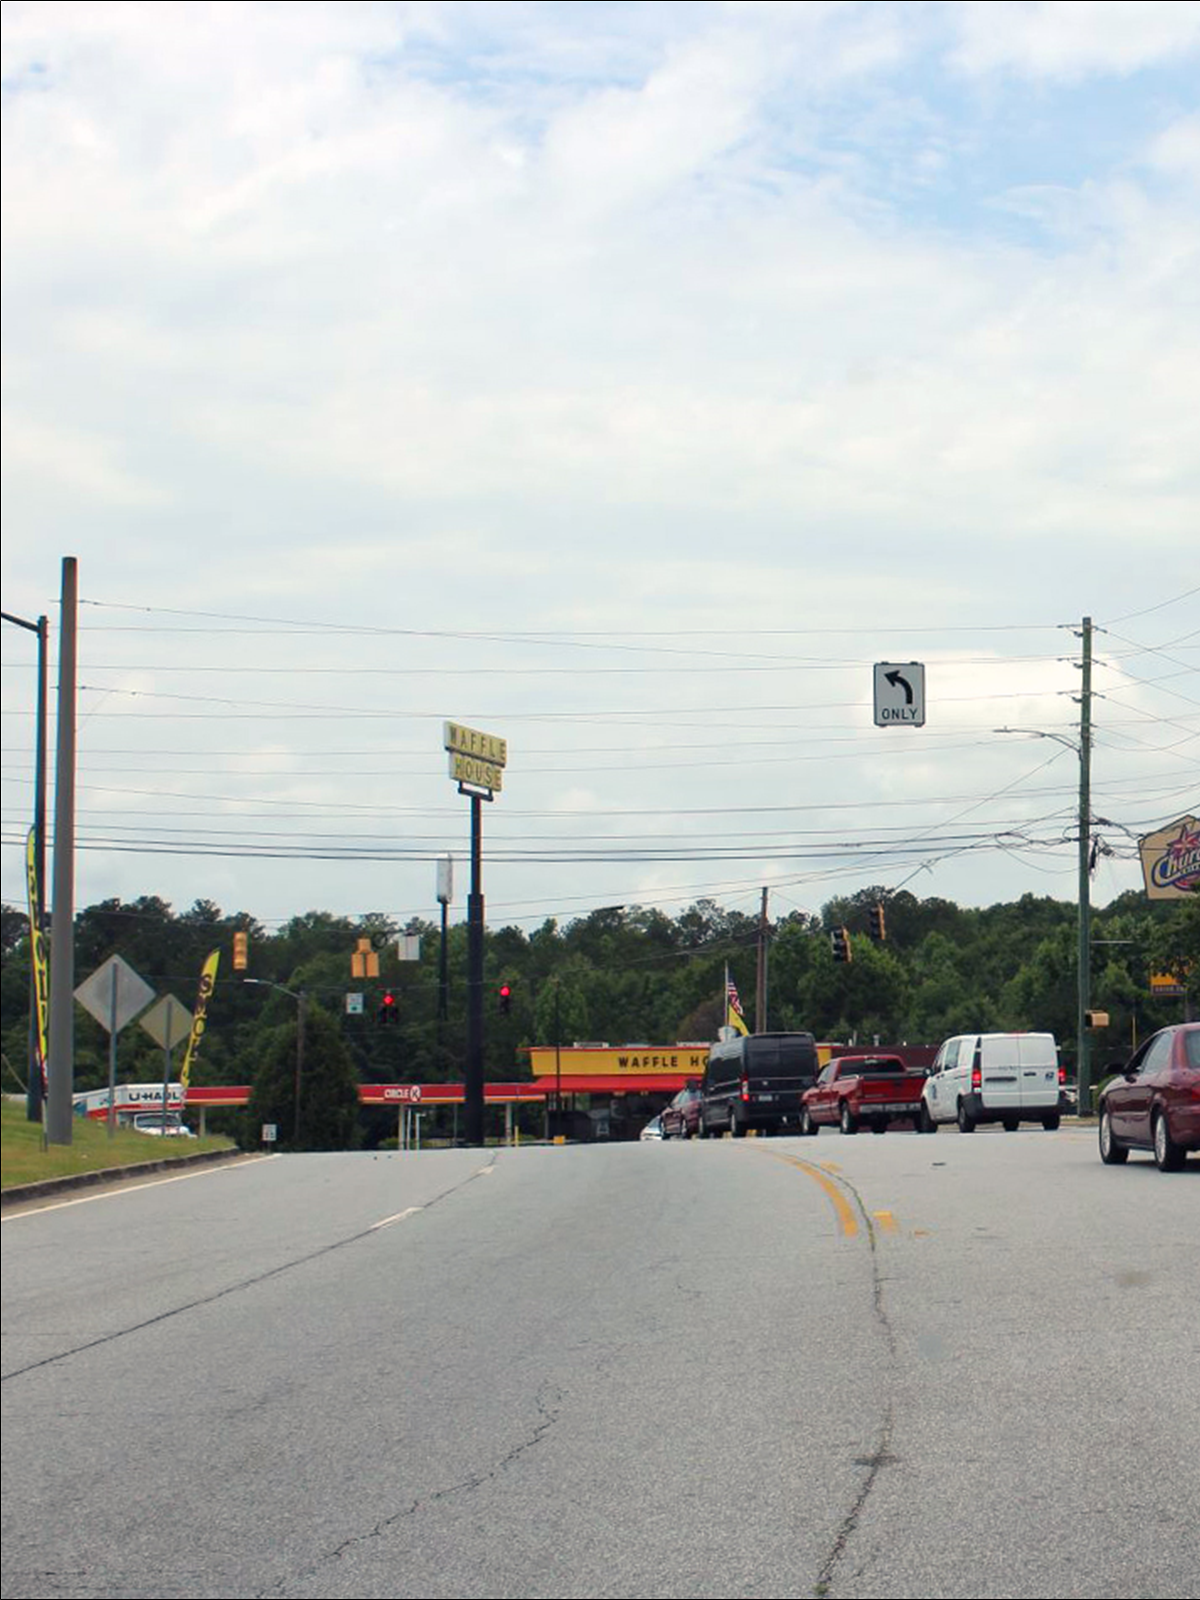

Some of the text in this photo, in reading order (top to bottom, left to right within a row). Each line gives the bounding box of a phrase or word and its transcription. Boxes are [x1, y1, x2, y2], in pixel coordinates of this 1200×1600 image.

[881, 707, 919, 720] ONLY
[449, 725, 506, 760] WAFFLE
[455, 756, 502, 787] HOUSE
[618, 1056, 679, 1068] WAFFLE
[384, 1087, 420, 1100] CIRCLE K
